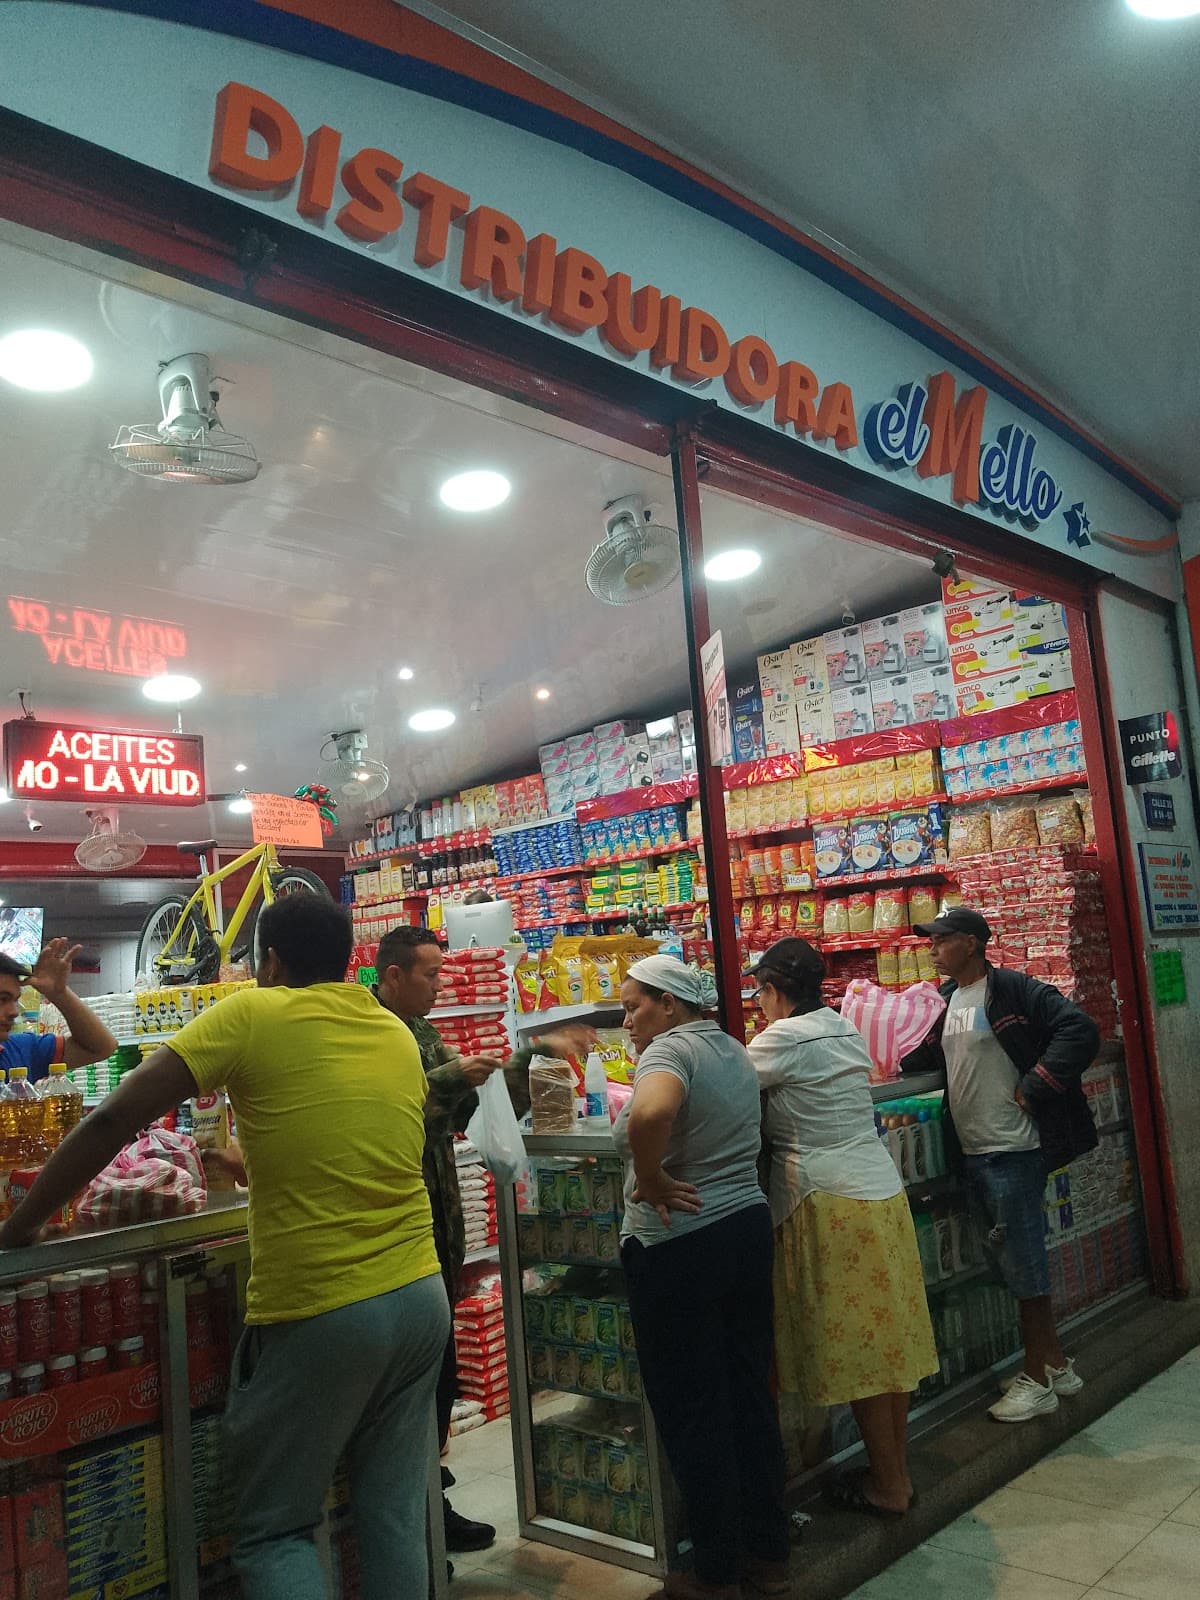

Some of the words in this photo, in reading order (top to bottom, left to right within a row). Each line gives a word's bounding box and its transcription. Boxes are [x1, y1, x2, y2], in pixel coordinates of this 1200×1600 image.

[208, 81, 859, 450] DISTRIBUIDORA
[866, 381, 929, 468] el
[917, 370, 1063, 522] Mello
[797, 638, 818, 655] Oster
[763, 652, 785, 667] Oster
[736, 684, 755, 698] Oster
[1130, 729, 1170, 745] PUNTO
[47, 730, 175, 765] ACEITES
[1131, 750, 1176, 767] Gillette
[84, 763, 125, 793] LA
